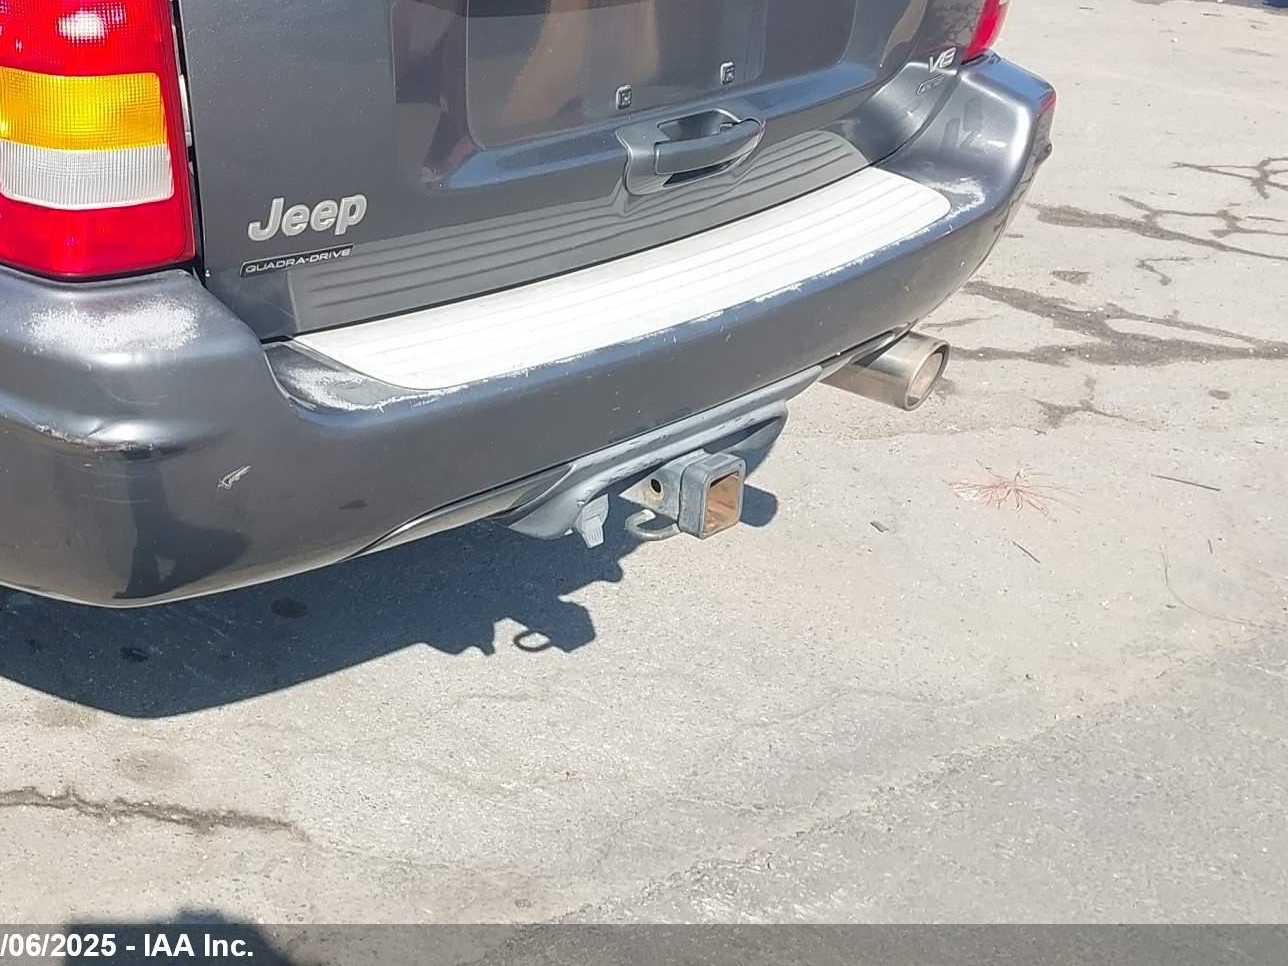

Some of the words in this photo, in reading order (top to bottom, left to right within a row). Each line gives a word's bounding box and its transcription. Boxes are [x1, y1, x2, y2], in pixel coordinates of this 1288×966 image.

[929, 46, 957, 73] V8
[247, 194, 367, 241] Jeep
[245, 248, 351, 274] QUADRA-DRIVE
